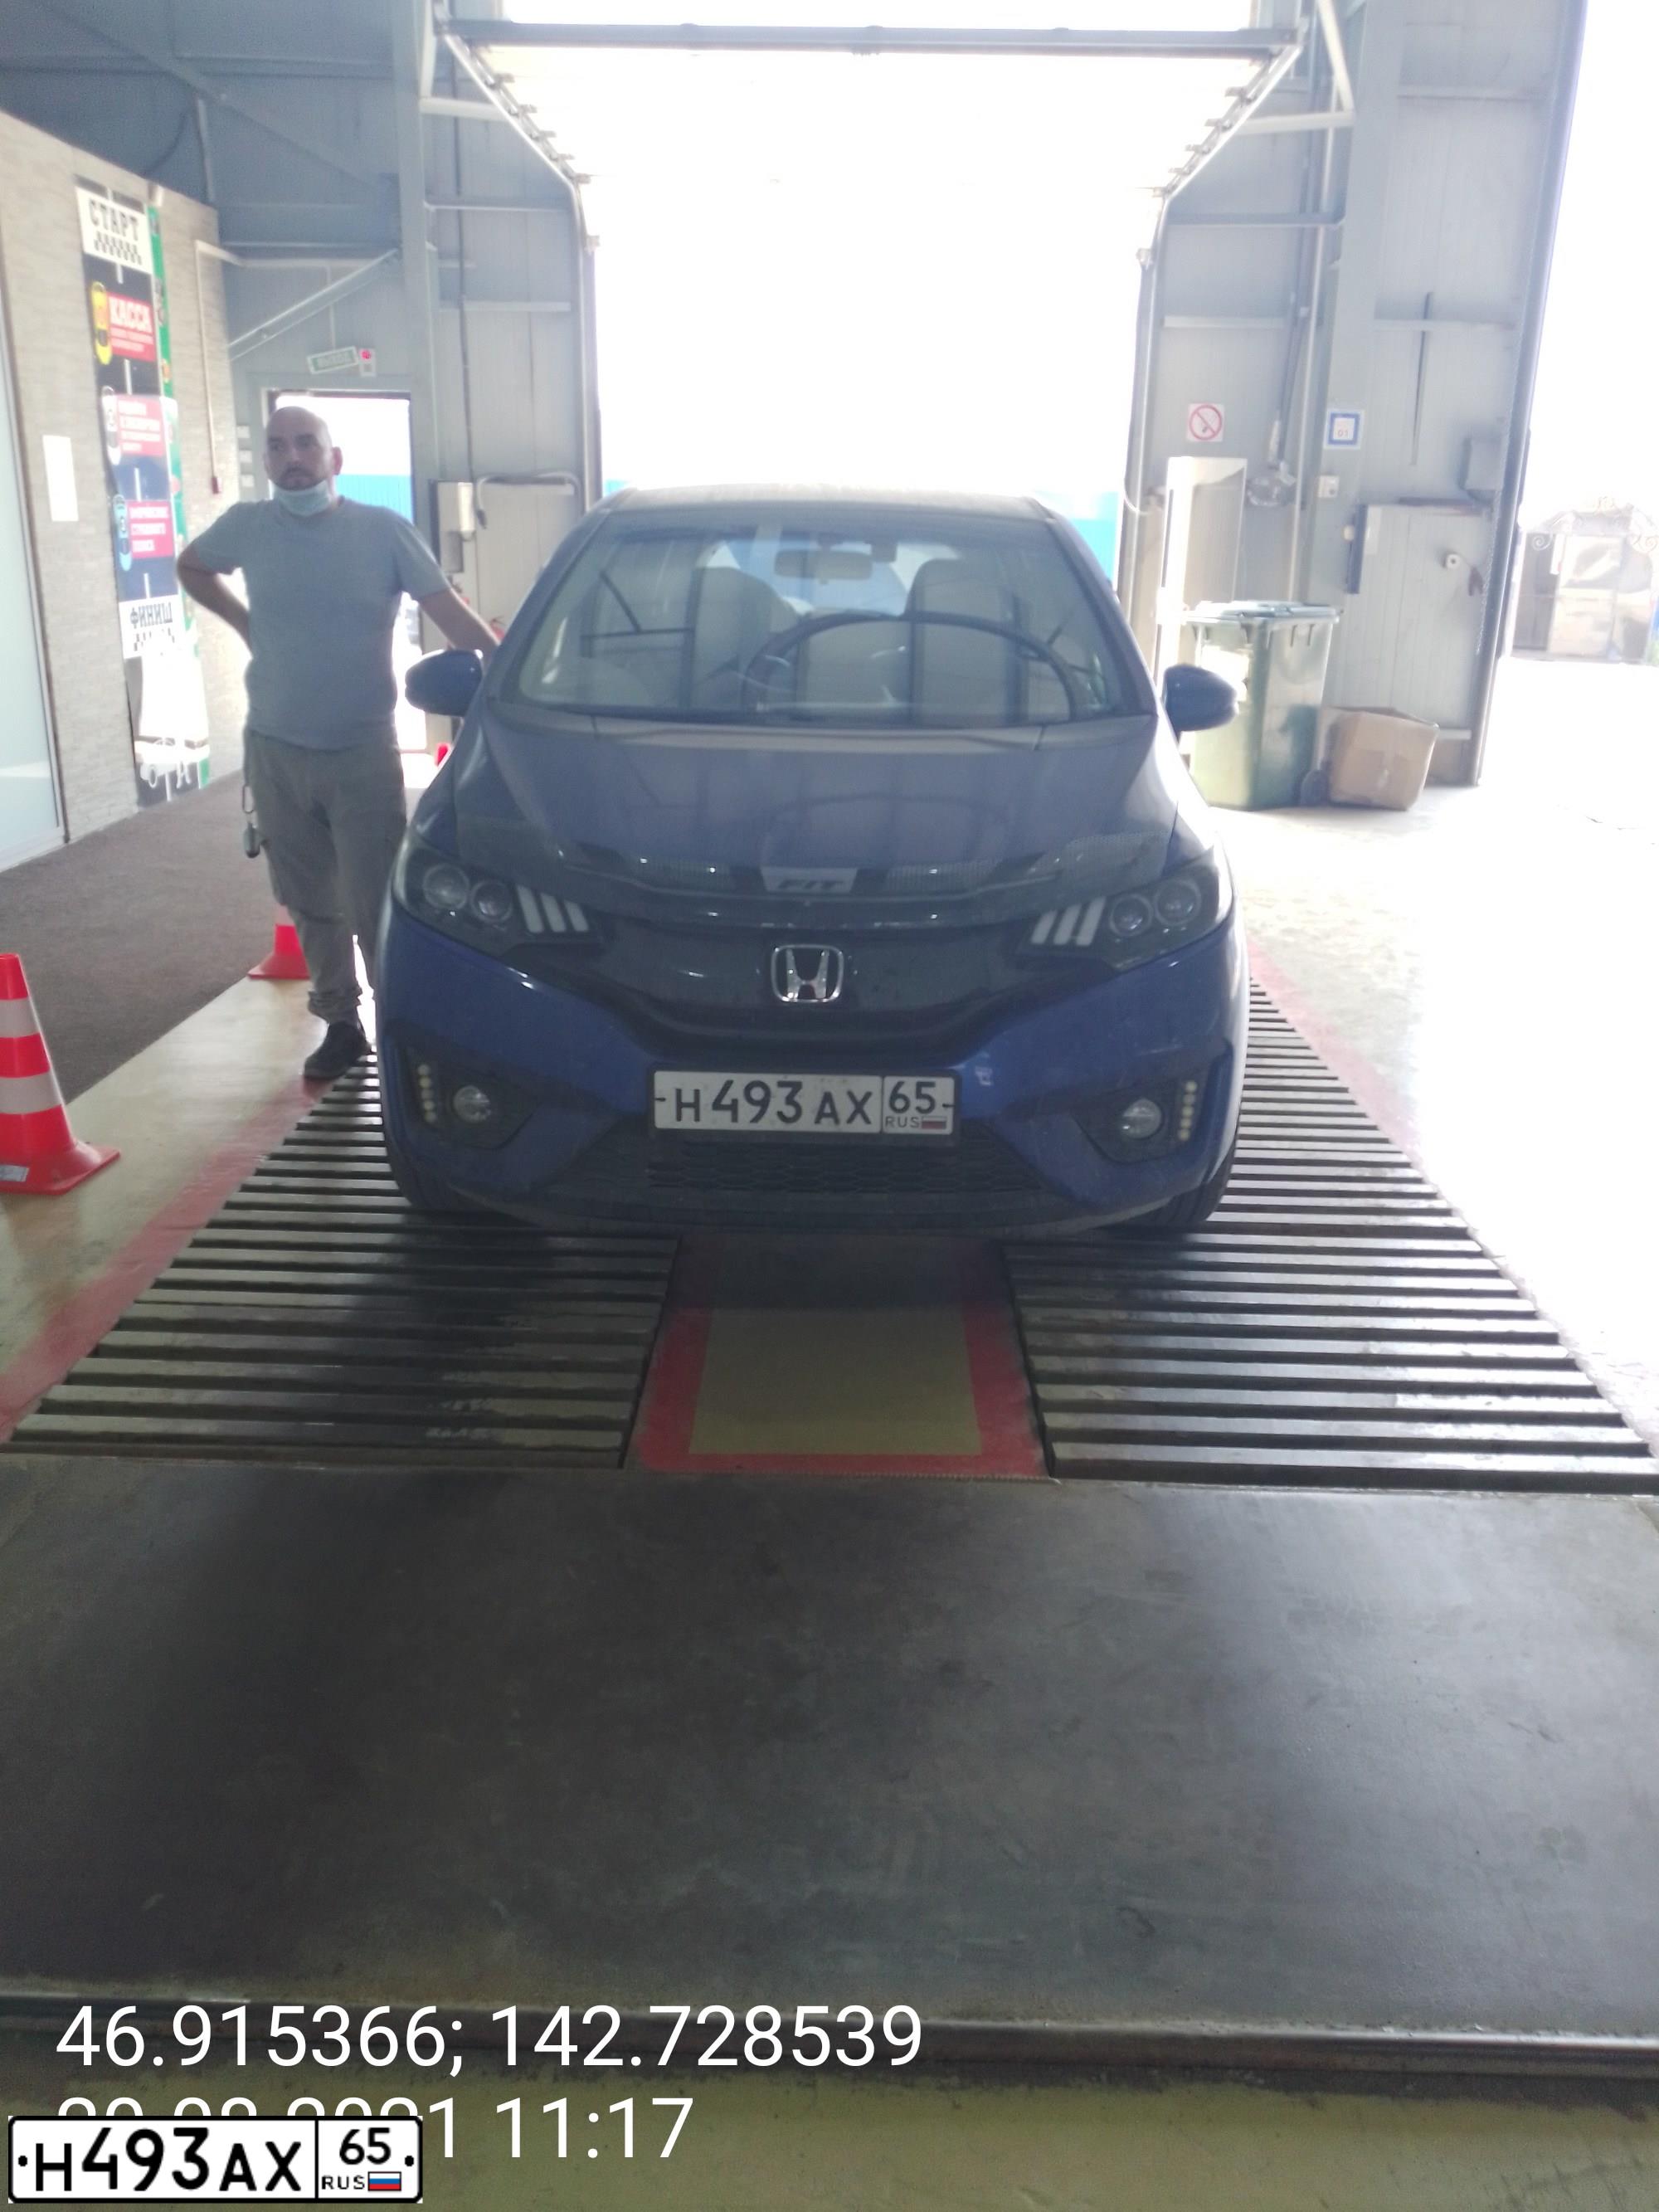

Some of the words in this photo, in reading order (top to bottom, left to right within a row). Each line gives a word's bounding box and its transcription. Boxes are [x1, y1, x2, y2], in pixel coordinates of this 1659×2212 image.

[89, 198, 139, 241] СТАРТ
[130, 602, 173, 629] ФИНИШ
[888, 1081, 936, 1114] 65
[885, 1117, 920, 1128] RUS
